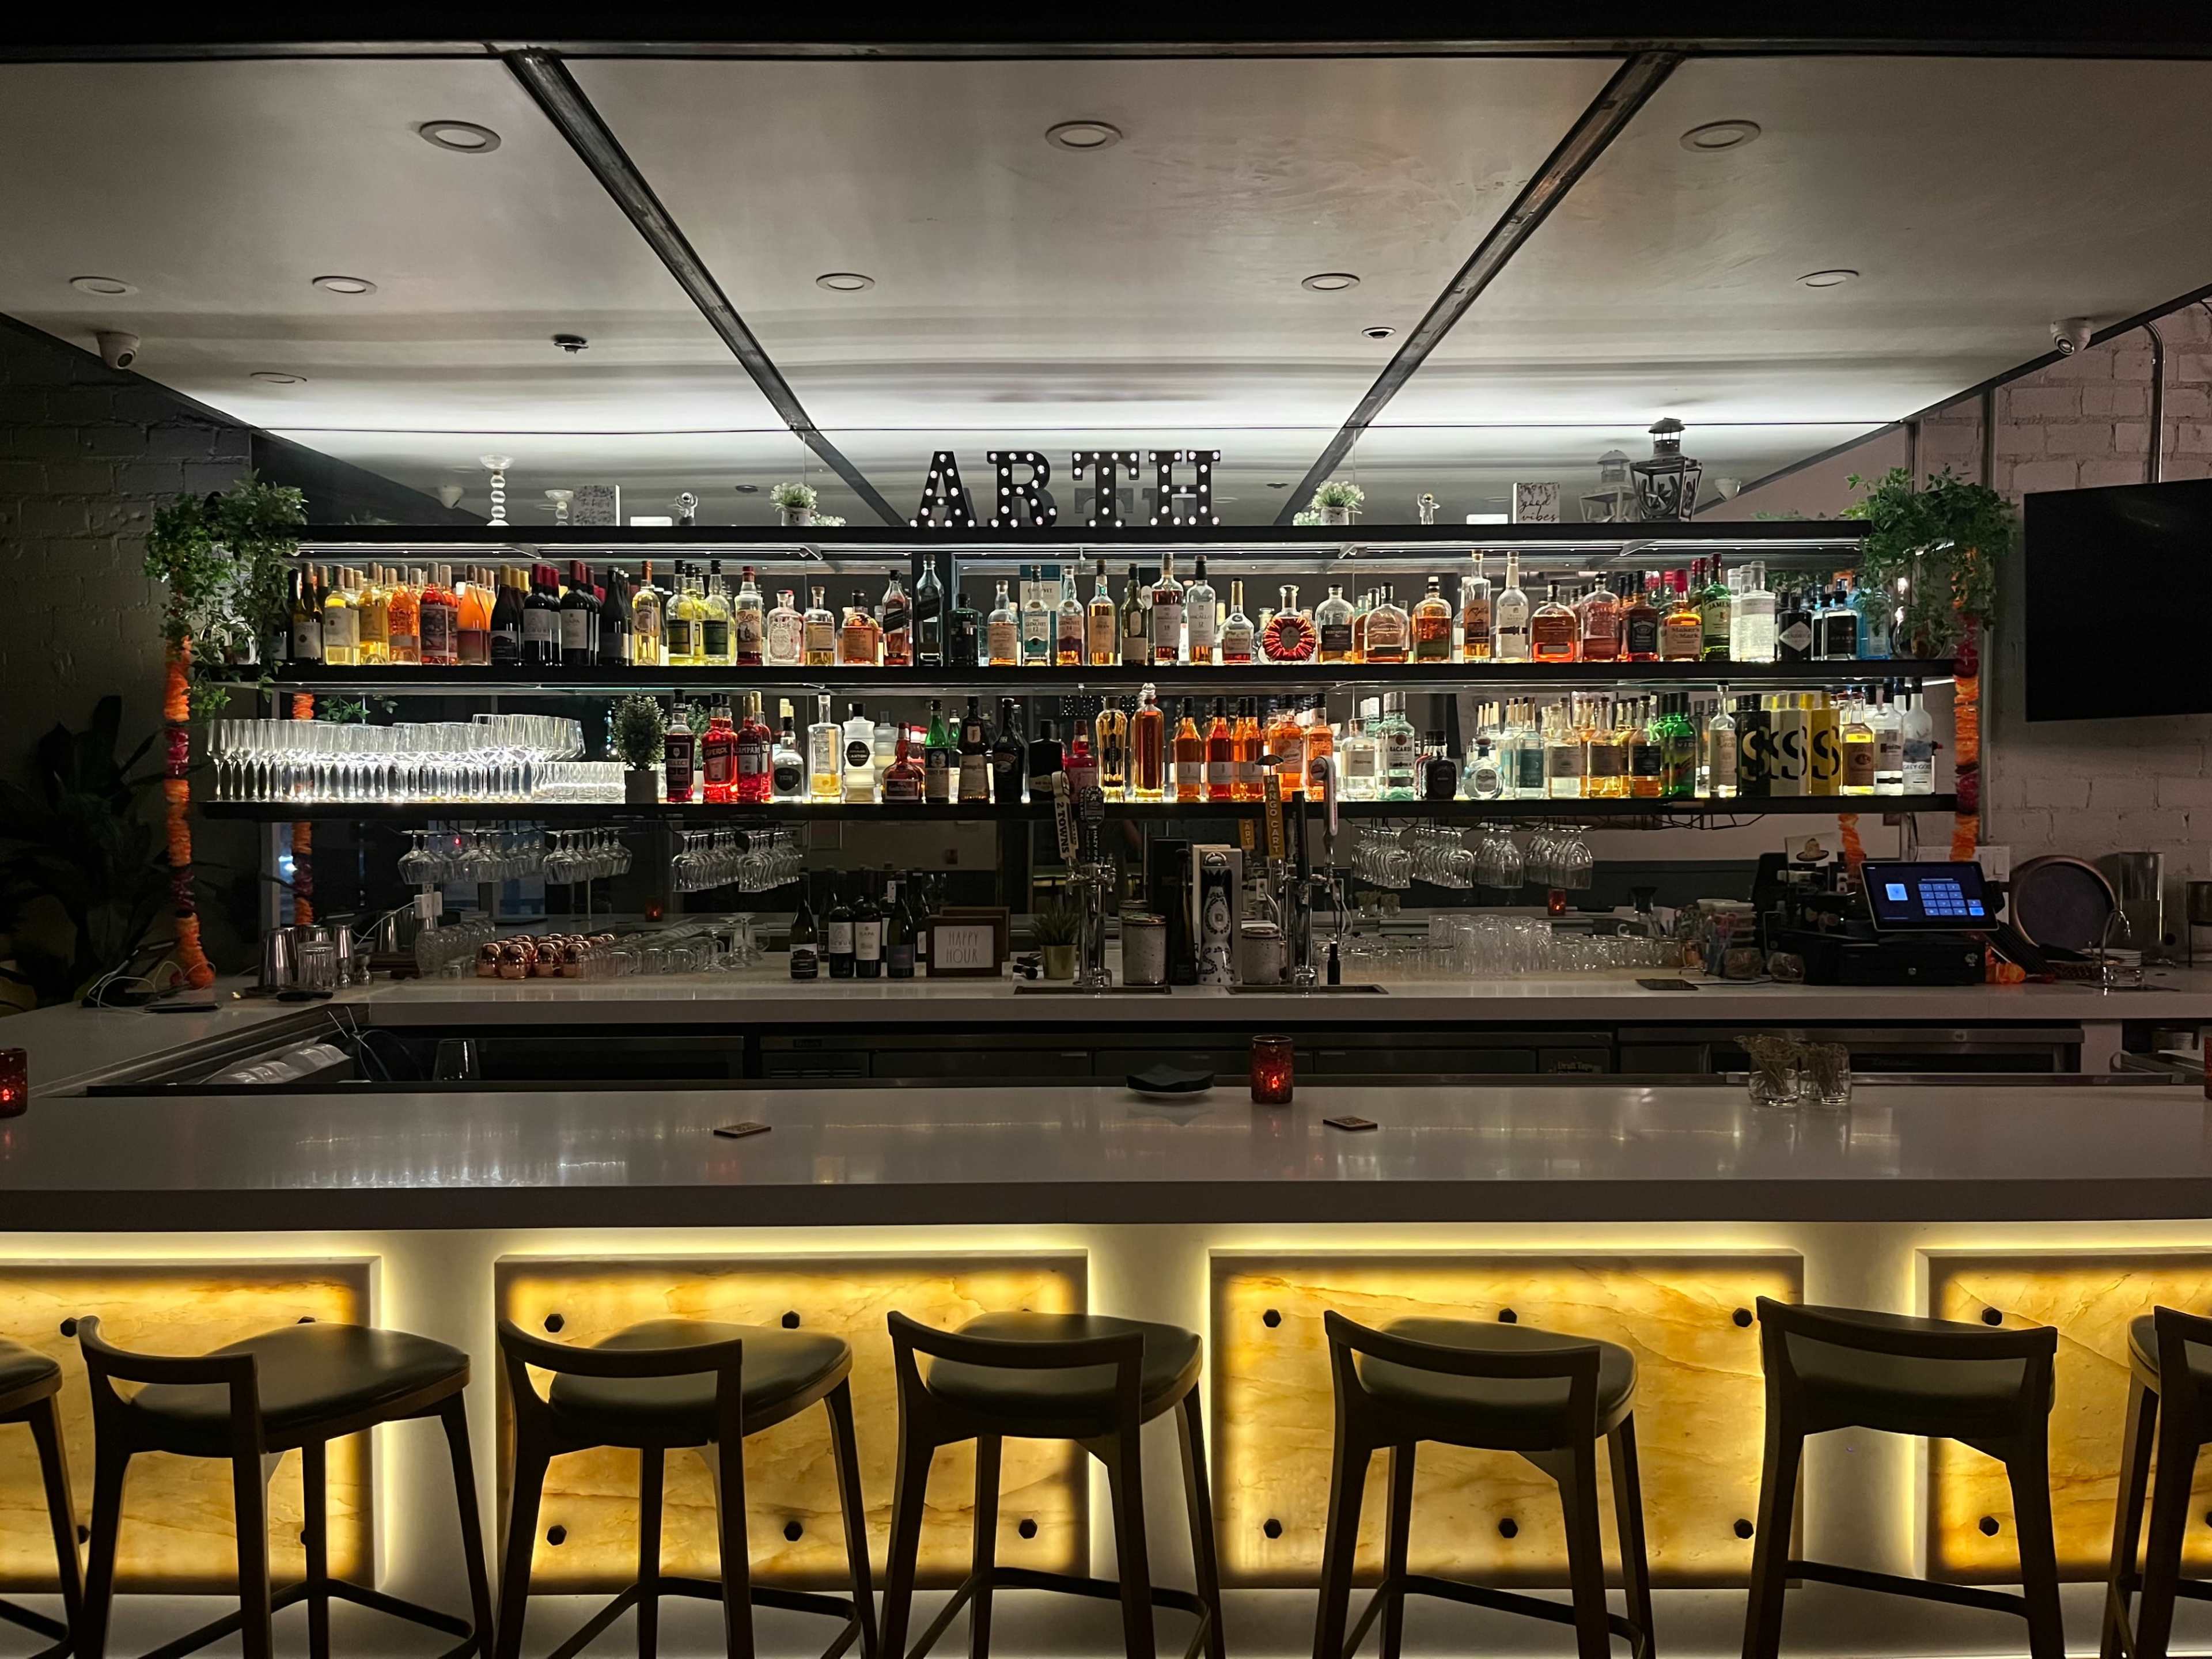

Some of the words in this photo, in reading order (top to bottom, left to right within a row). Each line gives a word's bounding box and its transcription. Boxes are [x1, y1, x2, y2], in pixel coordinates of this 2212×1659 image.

[910, 450, 1220, 527] ARTH
[1522, 506, 1557, 522] vibes
[1812, 726, 1840, 780] S
[1267, 777, 1277, 816] MANGO
[1058, 811, 1069, 853] TOWNS
[1271, 821, 1279, 853] CART
[946, 948, 978, 964] HOUR
[949, 931, 978, 947] HAPPY
